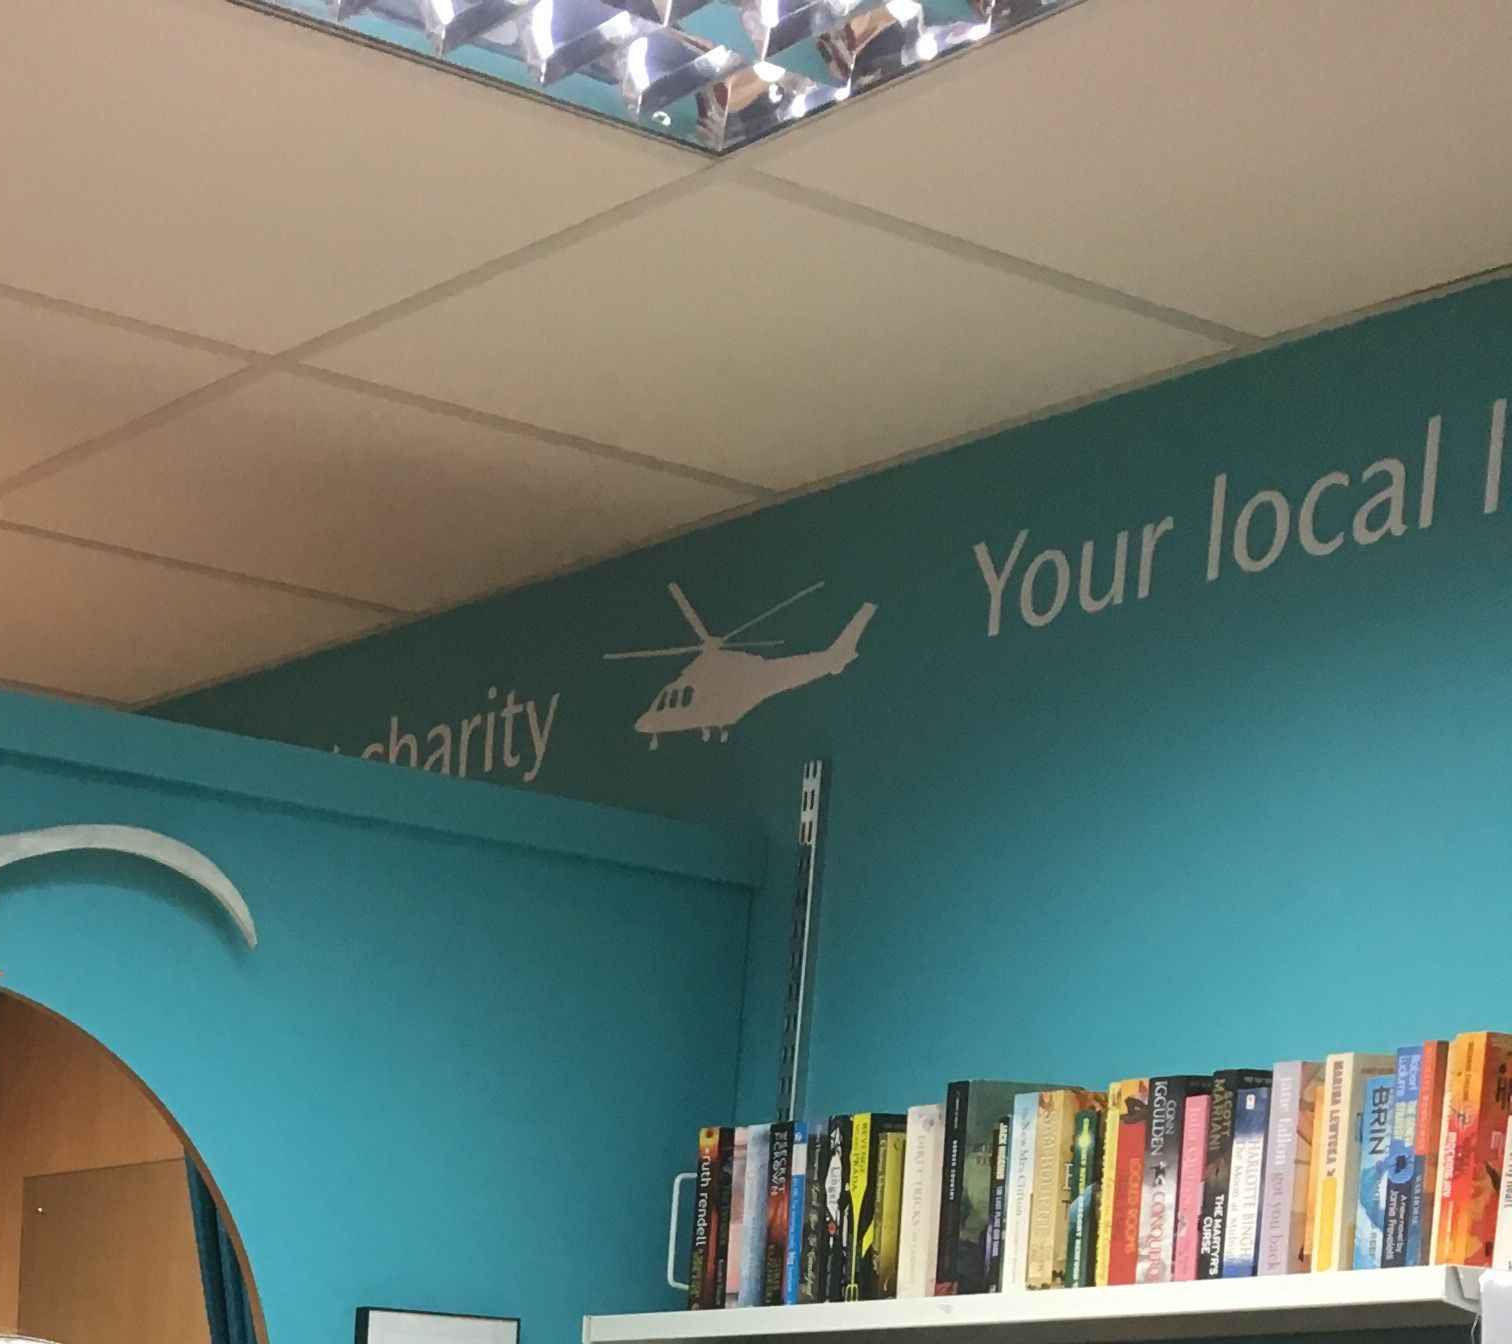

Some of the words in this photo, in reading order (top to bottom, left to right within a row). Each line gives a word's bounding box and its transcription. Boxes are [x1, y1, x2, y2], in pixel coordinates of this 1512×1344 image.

[972, 516, 1174, 637] Your
[1206, 414, 1441, 582] local
[1277, 1075, 1292, 1111] jane
[998, 1123, 1007, 1144] JACK
[1043, 1110, 1057, 1149] SAM
[1151, 1081, 1168, 1156] IGGULDEN
[1209, 1078, 1226, 1151] MARIANI
[1368, 1086, 1391, 1155] BRIN
[1275, 1118, 1294, 1165] fallon
[700, 1155, 712, 1187] ruth
[1270, 1172, 1285, 1196] got
[695, 1192, 708, 1246] rendell
[912, 1181, 922, 1226] TRICKS
[1214, 1194, 1225, 1216] THE
[1267, 1202, 1282, 1229] you
[1201, 1216, 1212, 1254] CURSE
[1209, 1219, 1222, 1275] MARTYR'S
[1267, 1235, 1281, 1272] back
